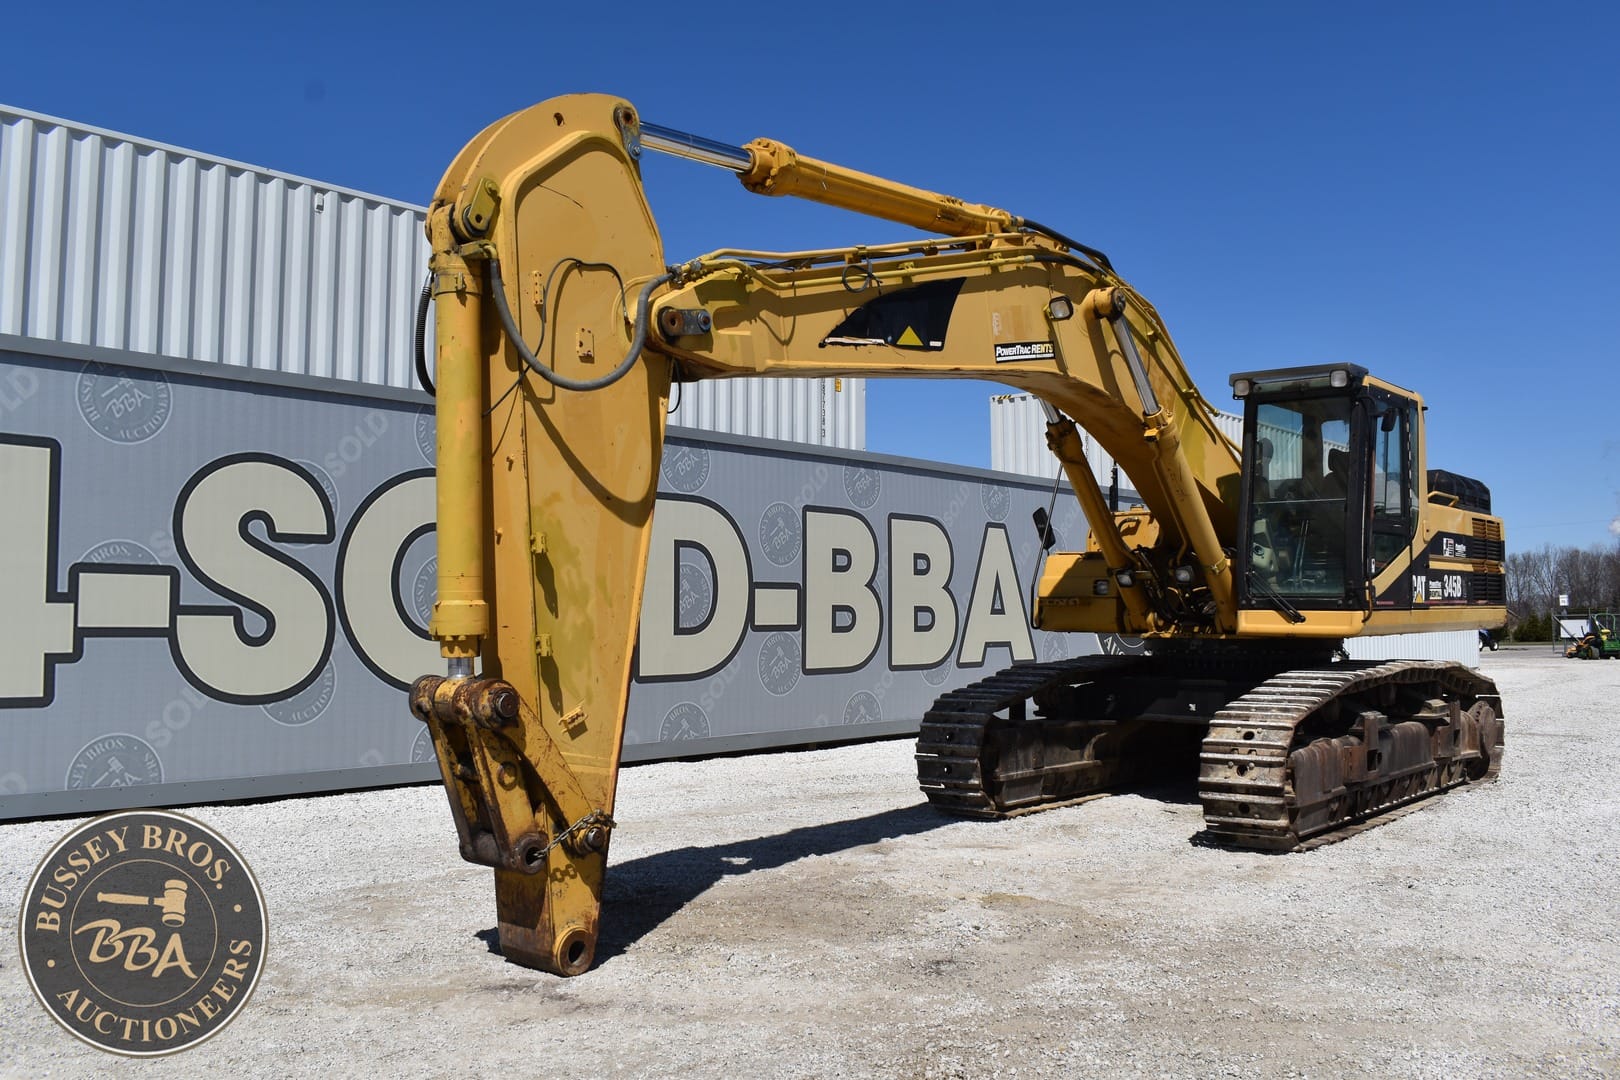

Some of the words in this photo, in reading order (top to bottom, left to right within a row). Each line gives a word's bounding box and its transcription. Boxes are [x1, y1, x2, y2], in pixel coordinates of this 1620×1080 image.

[1031, 343, 1054, 354] RENTS
[324, 411, 388, 478] SOLD
[1412, 574, 1426, 603] CAT
[1443, 574, 1462, 598] 345B
[145, 686, 209, 749] SOL
